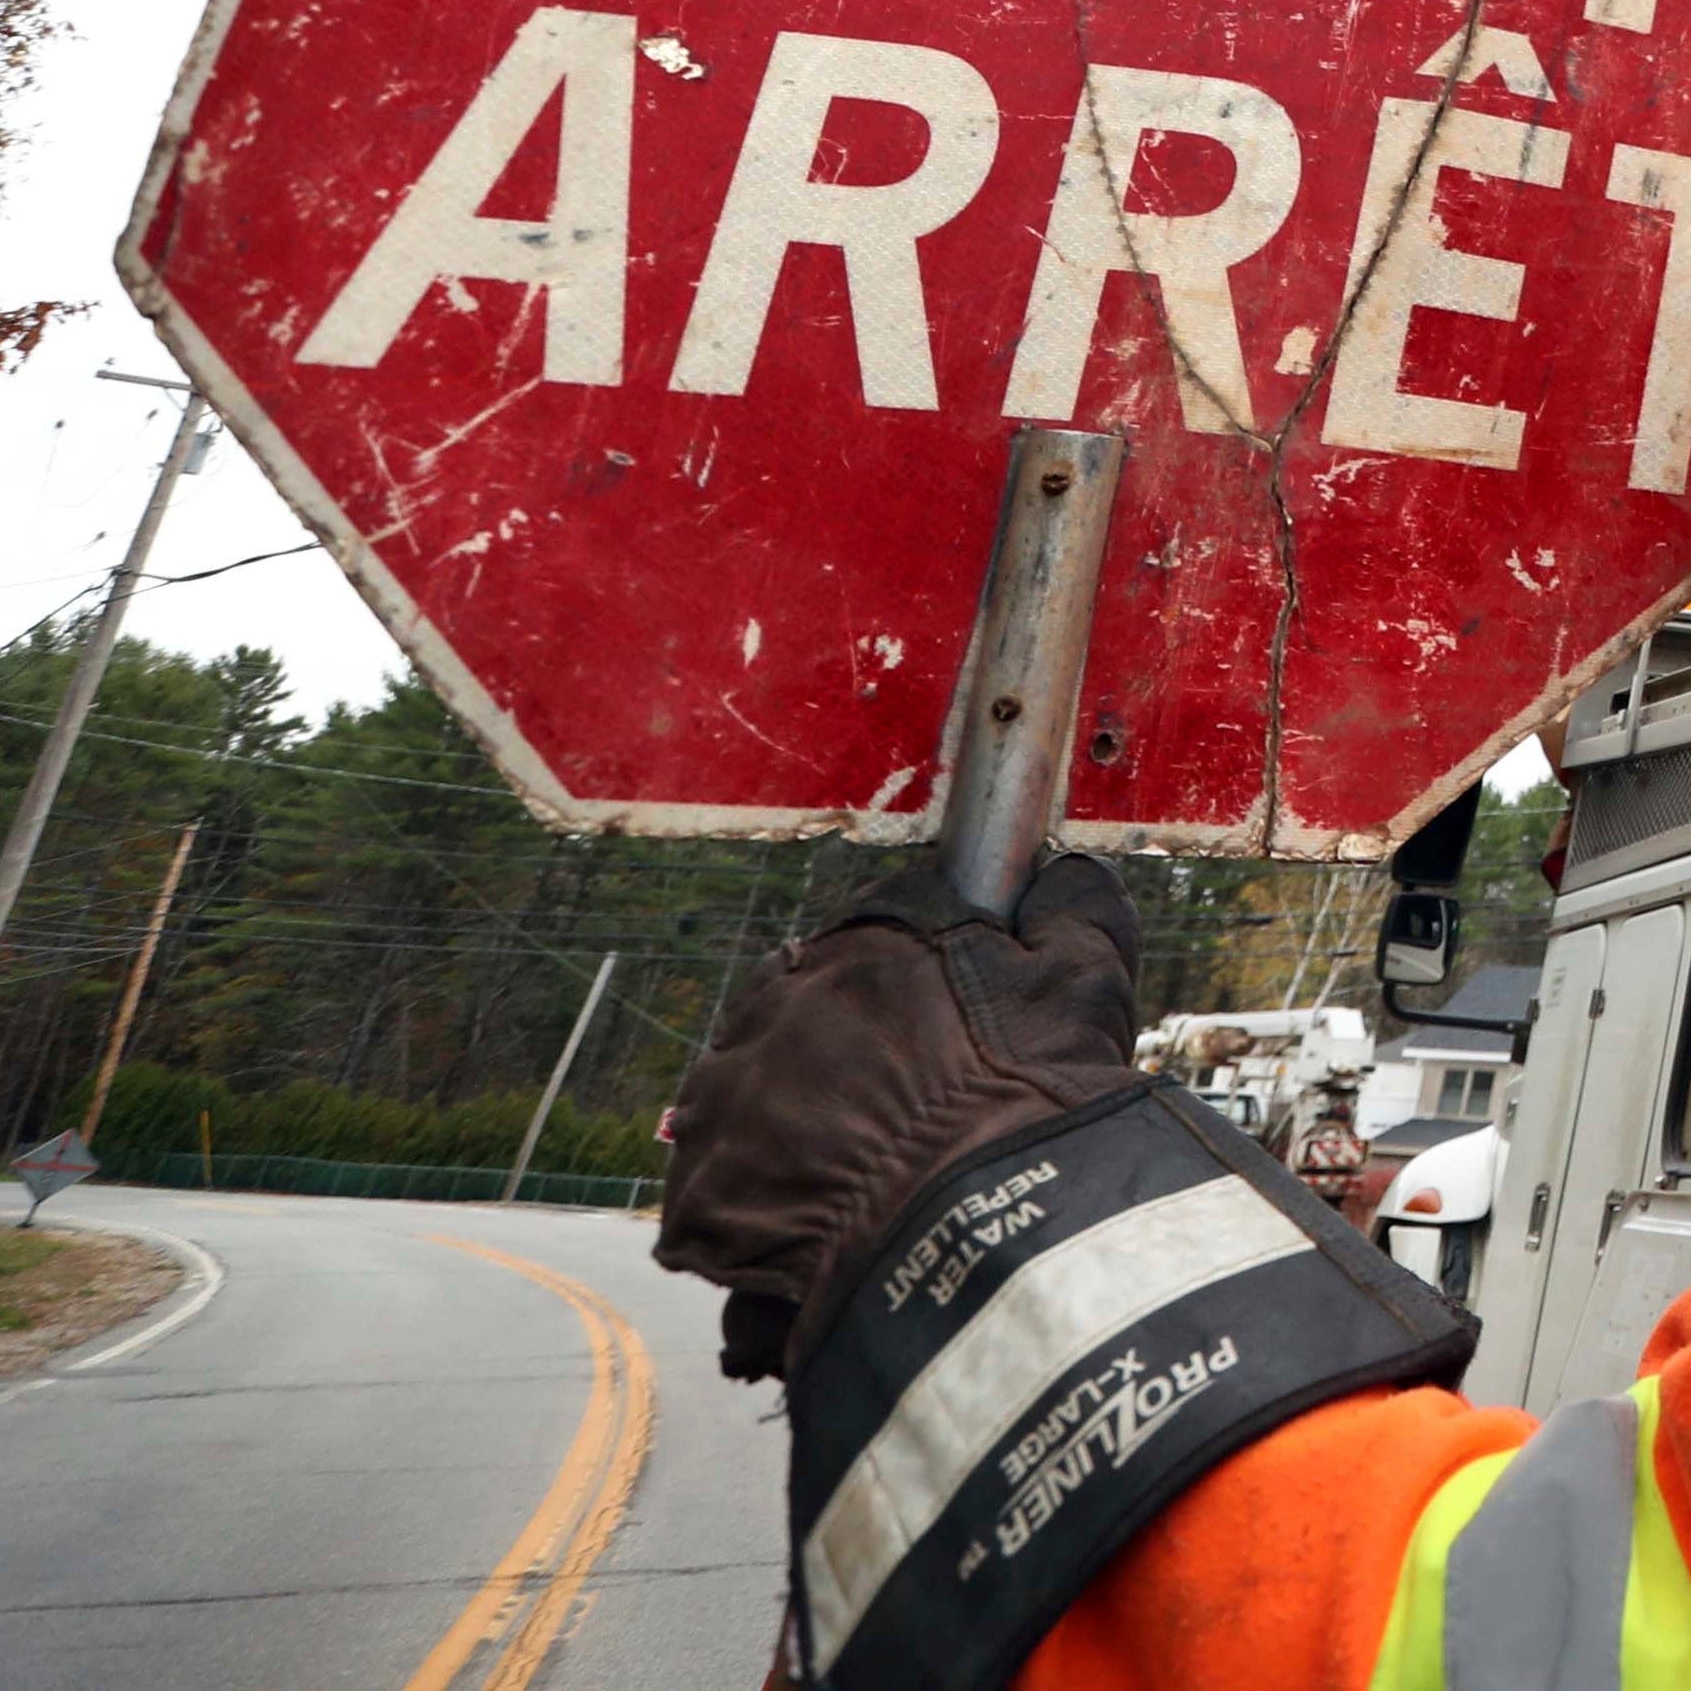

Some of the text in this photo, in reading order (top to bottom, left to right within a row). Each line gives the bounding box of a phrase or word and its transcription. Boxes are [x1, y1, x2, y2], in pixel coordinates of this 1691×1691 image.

[883, 1161, 1059, 1312] REPELLENT
[928, 1200, 1047, 1307] WATER
[998, 1347, 1147, 1486] X-LARGE
